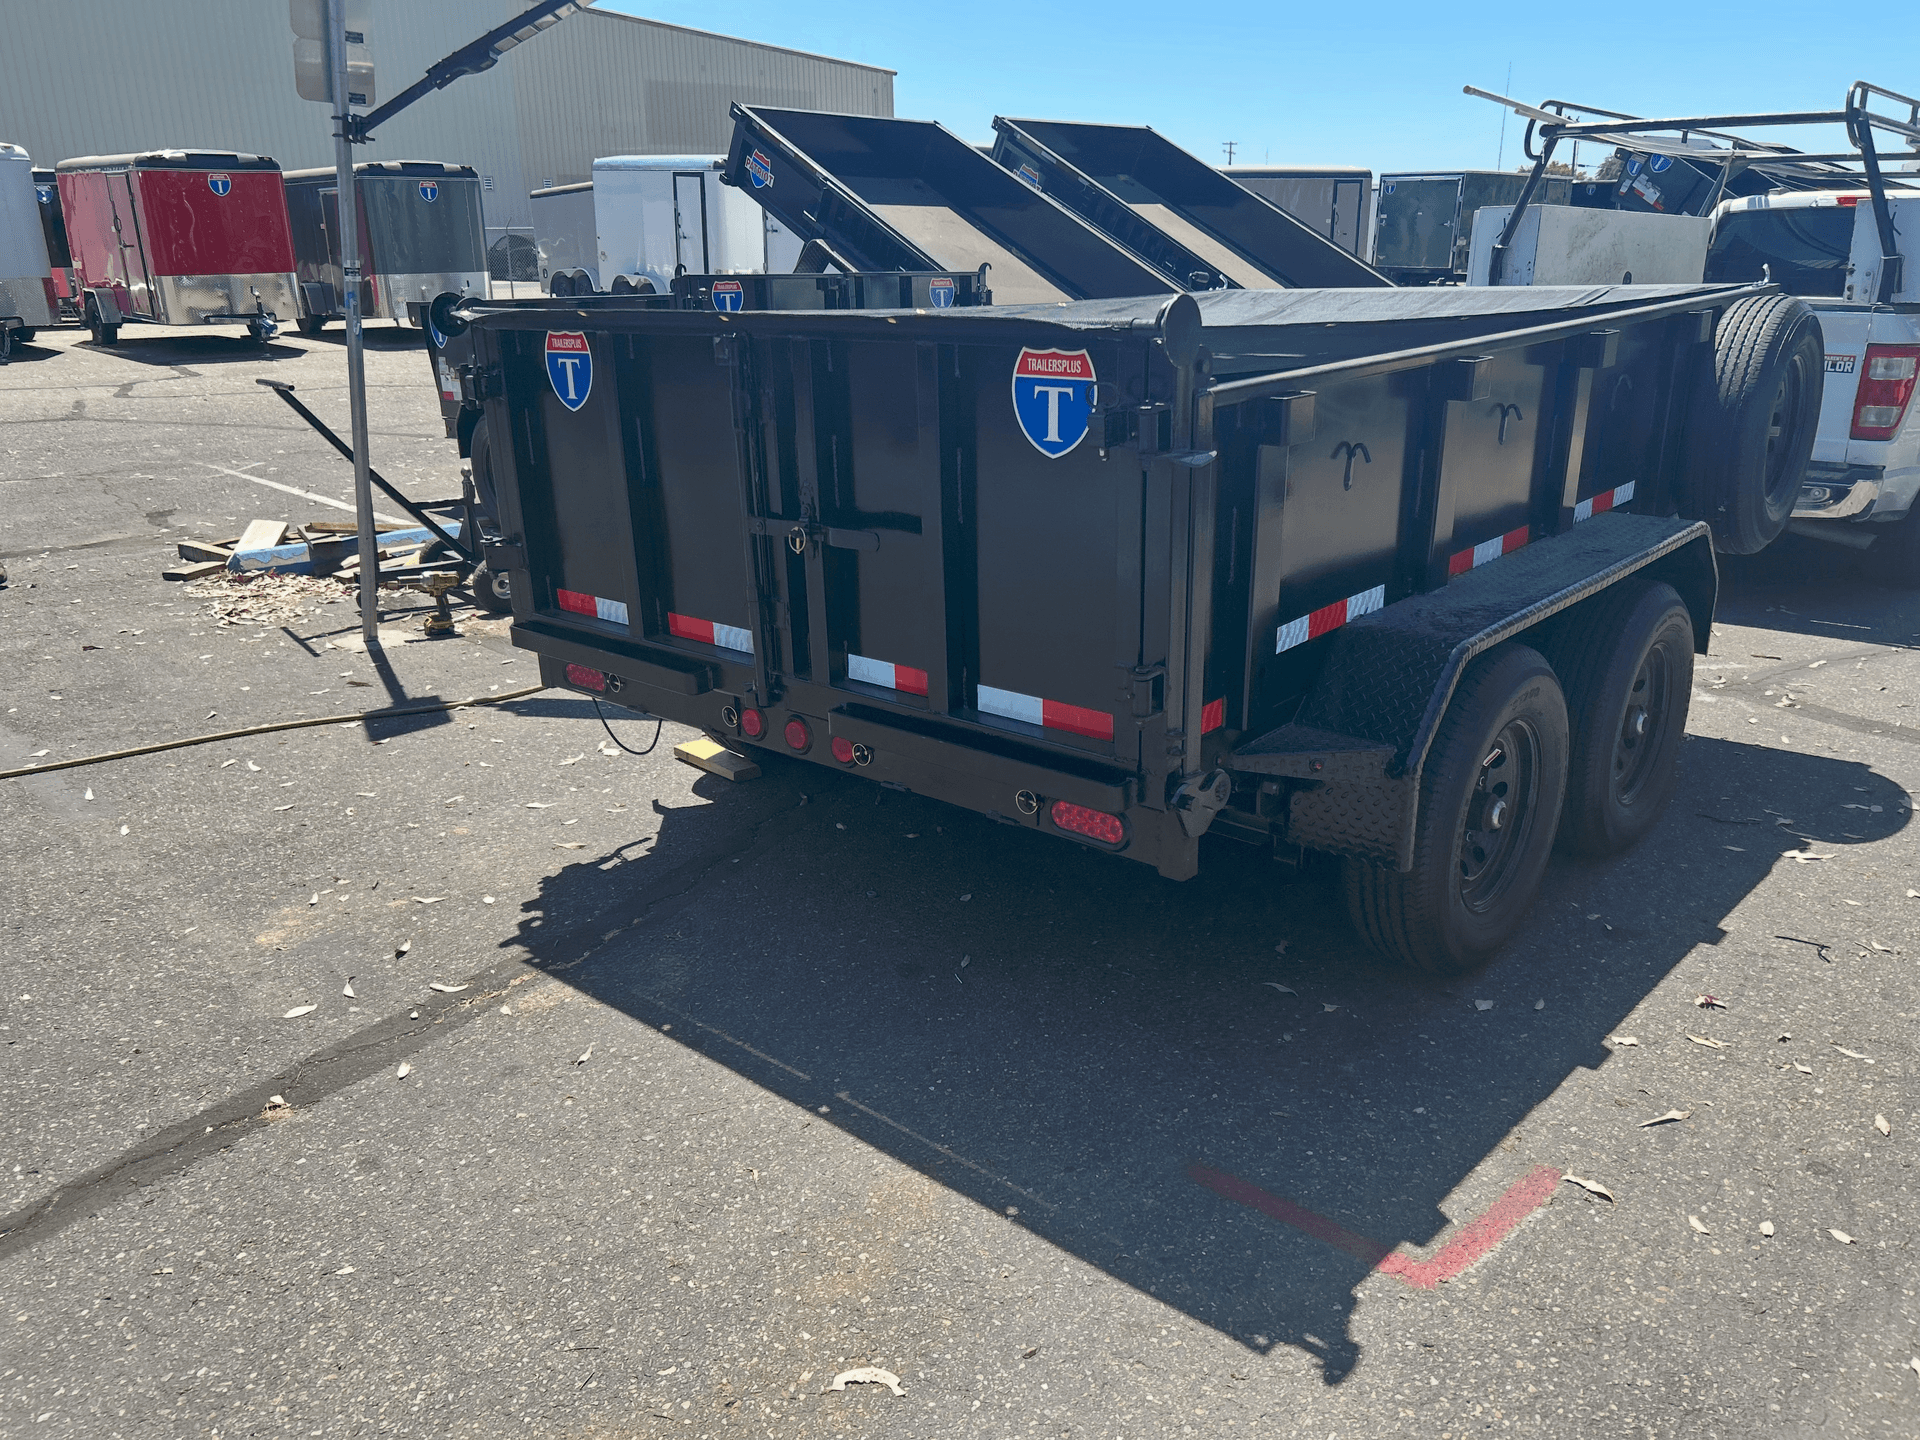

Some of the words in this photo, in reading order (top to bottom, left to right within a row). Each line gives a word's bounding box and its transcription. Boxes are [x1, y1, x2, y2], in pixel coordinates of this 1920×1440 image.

[746, 157, 774, 186] PATRIOT
[720, 293, 735, 311] T
[935, 289, 948, 307] T
[551, 338, 582, 349] TRAILERSPLUS
[1027, 358, 1082, 373] TRAILERSPLUS
[557, 357, 580, 399] T
[1034, 385, 1073, 443] T
